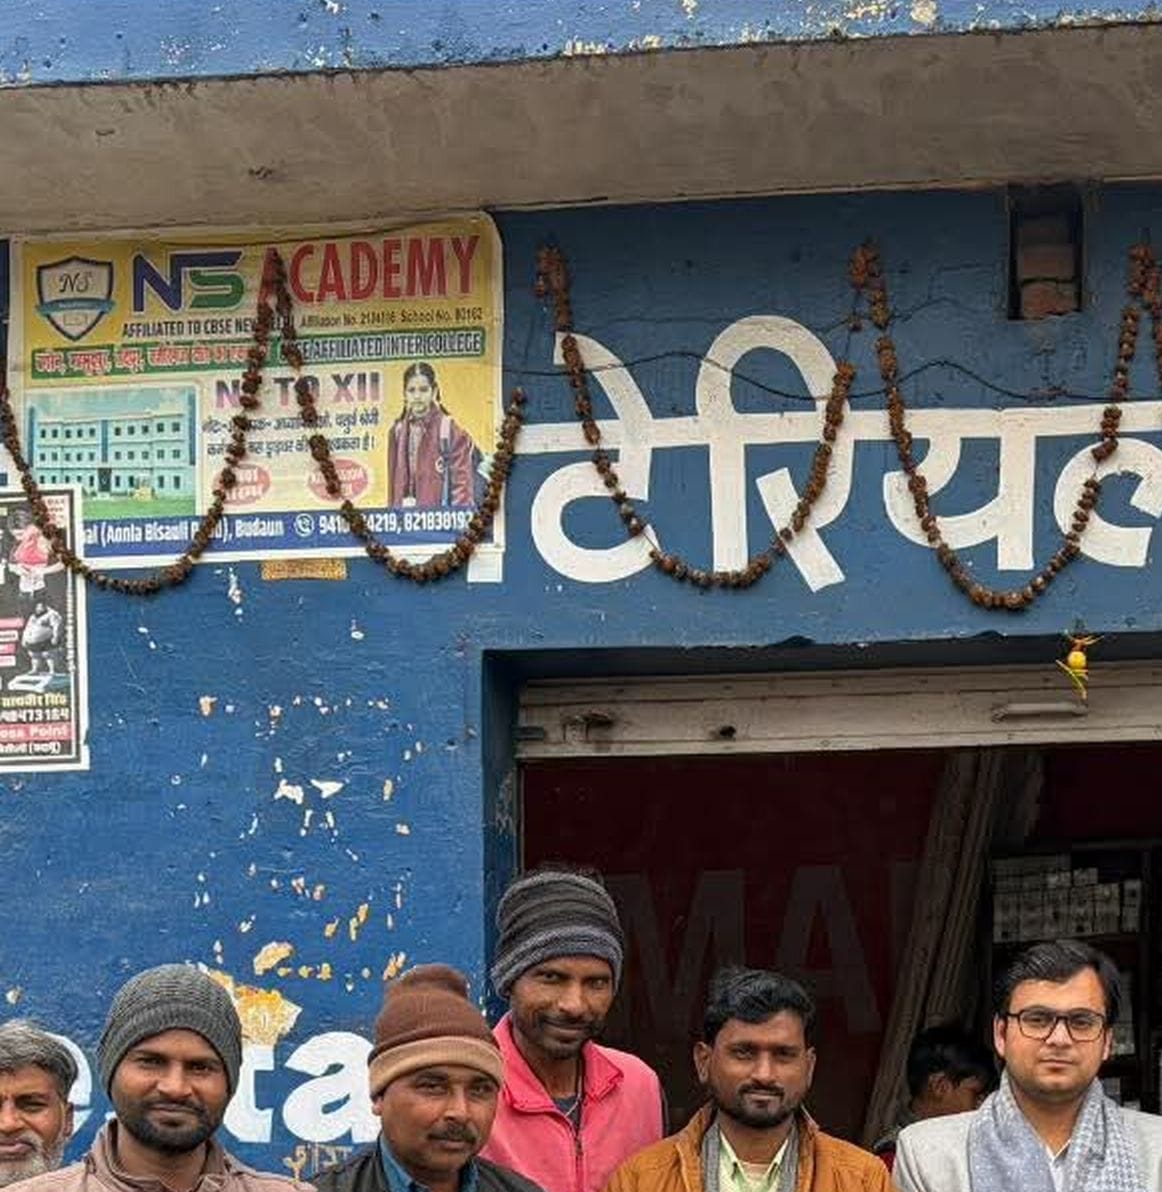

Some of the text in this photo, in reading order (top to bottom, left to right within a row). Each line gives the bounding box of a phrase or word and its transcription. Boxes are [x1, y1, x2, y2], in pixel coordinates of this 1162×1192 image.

[133, 235, 480, 312] NS ACADEMY
[123, 320, 185, 338] AFFILIATED
[187, 319, 201, 335] TO
[203, 317, 232, 334] CBSE
[401, 309, 435, 324] School
[385, 334, 423, 356] INTER
[426, 331, 482, 354] COLLEGE
[331, 371, 381, 403] XII
[235, 518, 285, 537] Budaun
